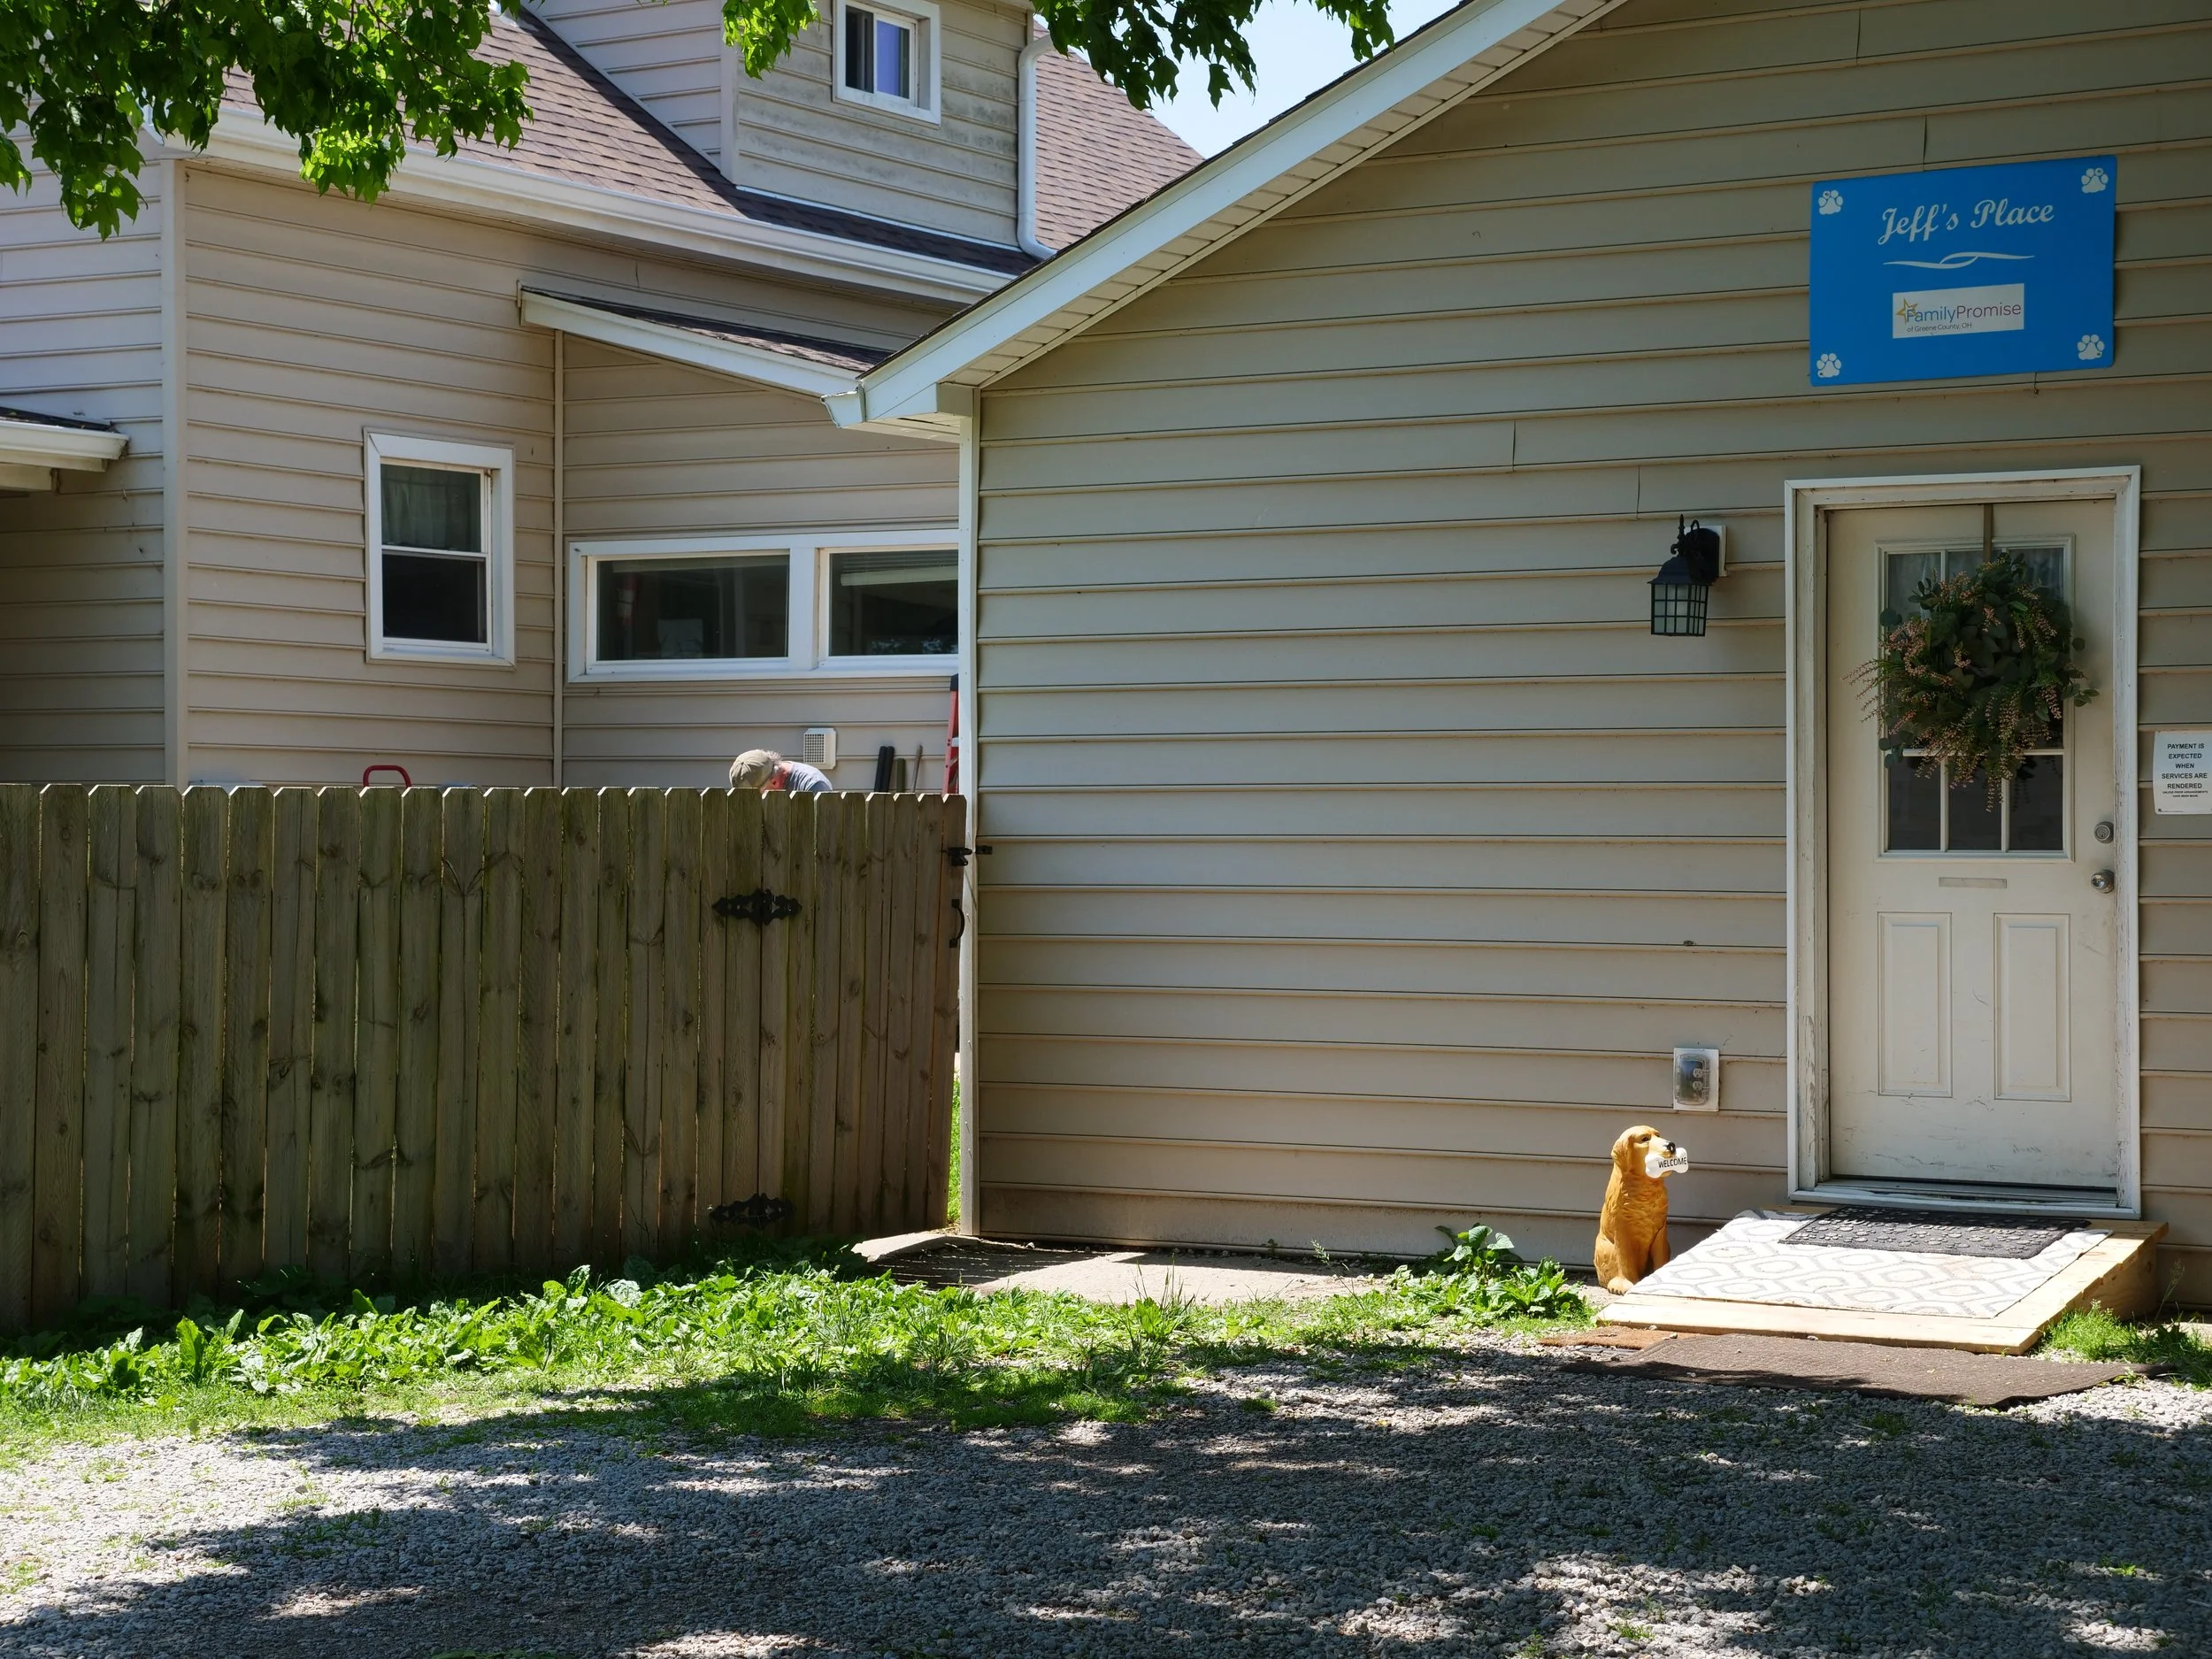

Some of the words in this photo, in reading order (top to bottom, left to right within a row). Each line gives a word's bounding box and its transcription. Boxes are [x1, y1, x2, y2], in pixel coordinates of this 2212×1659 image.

[1878, 204, 1959, 245] Jeff's
[1970, 198, 2055, 228] Place
[1658, 1157, 1687, 1169] WELCOME
